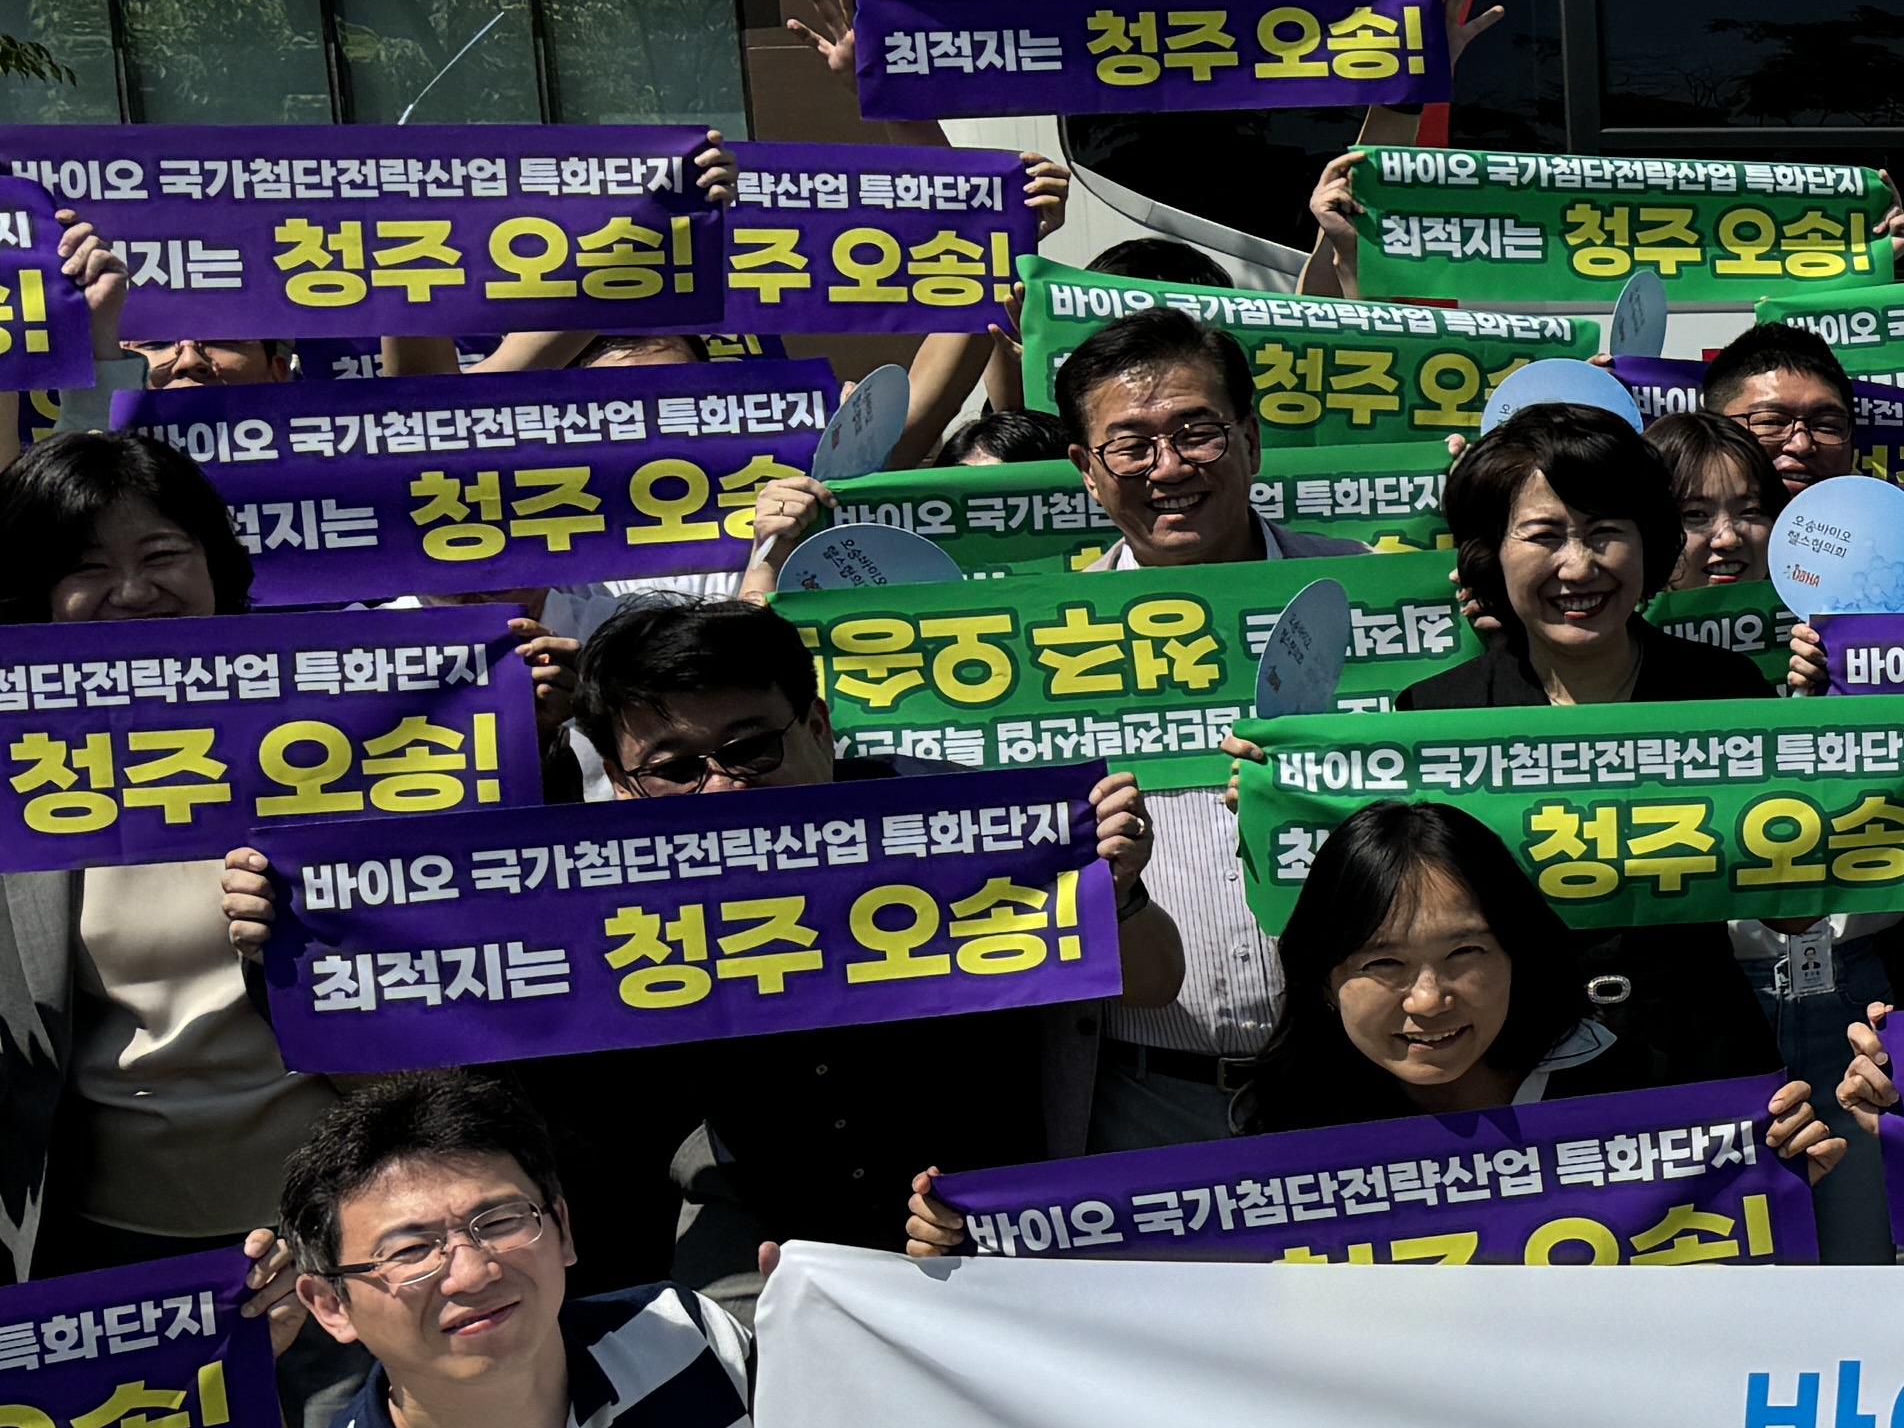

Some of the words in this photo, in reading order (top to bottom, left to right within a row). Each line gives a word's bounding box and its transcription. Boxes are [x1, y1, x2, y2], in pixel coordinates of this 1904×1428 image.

[885, 30, 1062, 74] 최적지는
[1087, 10, 1238, 85] 청주
[1255, 6, 1424, 78] 오송!
[160, 159, 507, 199] 국가첨단전략산업
[520, 157, 682, 195] 특화단지
[859, 175, 1002, 211] 특화단지
[1381, 152, 1478, 183] 바이오
[1487, 155, 1746, 191] 국가첨단전략산업
[1735, 161, 1863, 195] 특화단지
[274, 219, 465, 306] 청주
[485, 216, 693, 299] 오송!
[829, 228, 1013, 306] 오송!
[1382, 216, 1542, 258] 최적지는
[1566, 204, 1701, 276] 청주
[1716, 209, 1870, 277] 오송!
[1050, 284, 1154, 318] 바이오
[1165, 294, 1437, 336] 국가첨단전략산업
[1444, 309, 1574, 340] 특화단지
[1252, 344, 1399, 424] 청주
[290, 400, 646, 456] 국가첨단전략산업
[658, 391, 825, 436] 특화단지
[410, 466, 605, 561] 청주
[1296, 475, 1446, 516] 특화단지
[294, 644, 488, 694] 특화단지
[1033, 600, 1219, 694] 청주
[10, 728, 231, 833] 청주
[256, 713, 500, 816] 오송!
[1278, 749, 1408, 792] 바이오
[1420, 736, 1763, 788] 국가첨단전략산업
[302, 856, 459, 909] 바이오
[472, 819, 868, 893] 국가첨단전략산업
[882, 802, 1070, 857] 특화단지
[1529, 804, 1716, 898] 청주
[313, 942, 570, 1011] 최적지는
[605, 896, 823, 1008] 청주
[847, 870, 1081, 983] 오송!
[967, 1201, 1123, 1256] 바이오
[1132, 1147, 1543, 1235] 국가첨단전략산업
[1556, 1121, 1756, 1186] 특화단지
